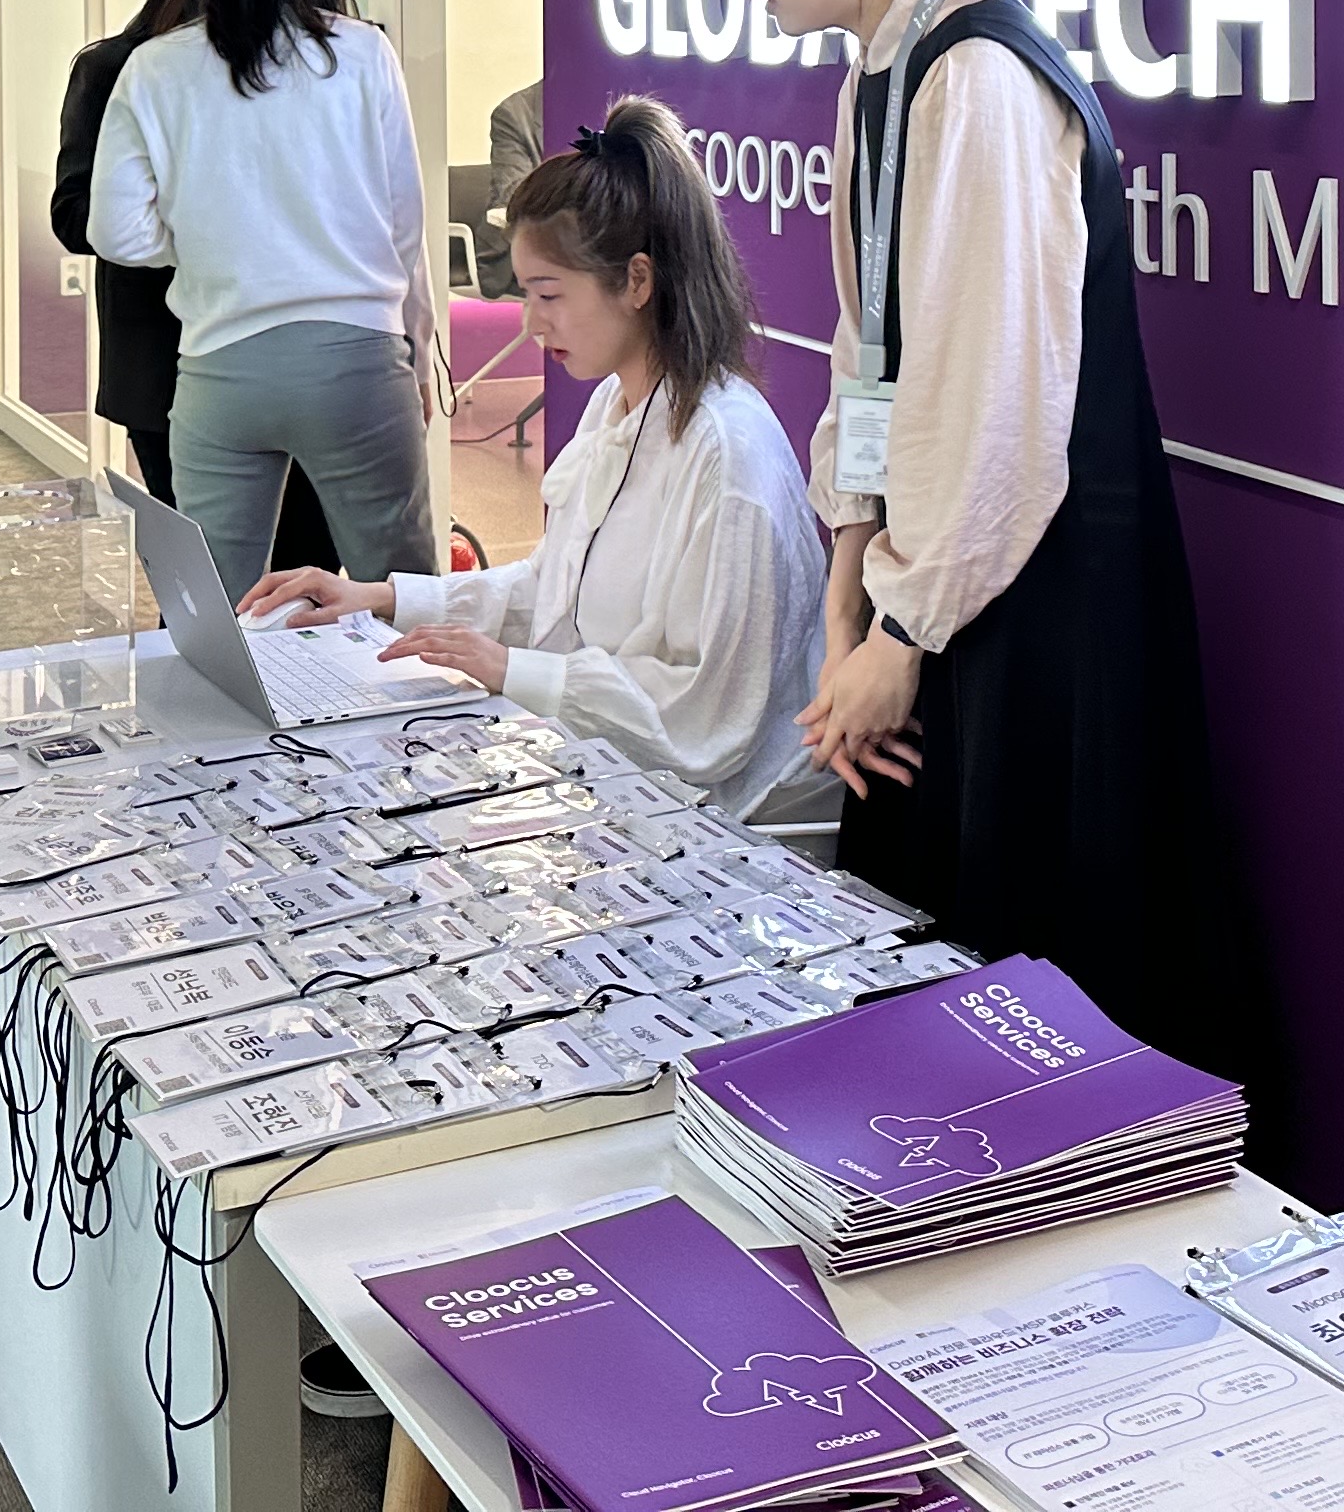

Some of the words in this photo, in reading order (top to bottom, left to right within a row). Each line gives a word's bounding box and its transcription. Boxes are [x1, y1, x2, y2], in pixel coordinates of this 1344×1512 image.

[159, 966, 215, 1006] 성낙복
[211, 1023, 281, 1063] 이동승
[959, 992, 1066, 1069] Services
[985, 982, 1087, 1058] Cloocus
[236, 1090, 305, 1136] 조현진
[424, 1267, 575, 1311] Cloocus
[441, 1282, 599, 1329] Services
[1014, 1317, 1049, 1333] MSP
[900, 1351, 979, 1383] 함께하는
[975, 1329, 1052, 1361] 비즈니스
